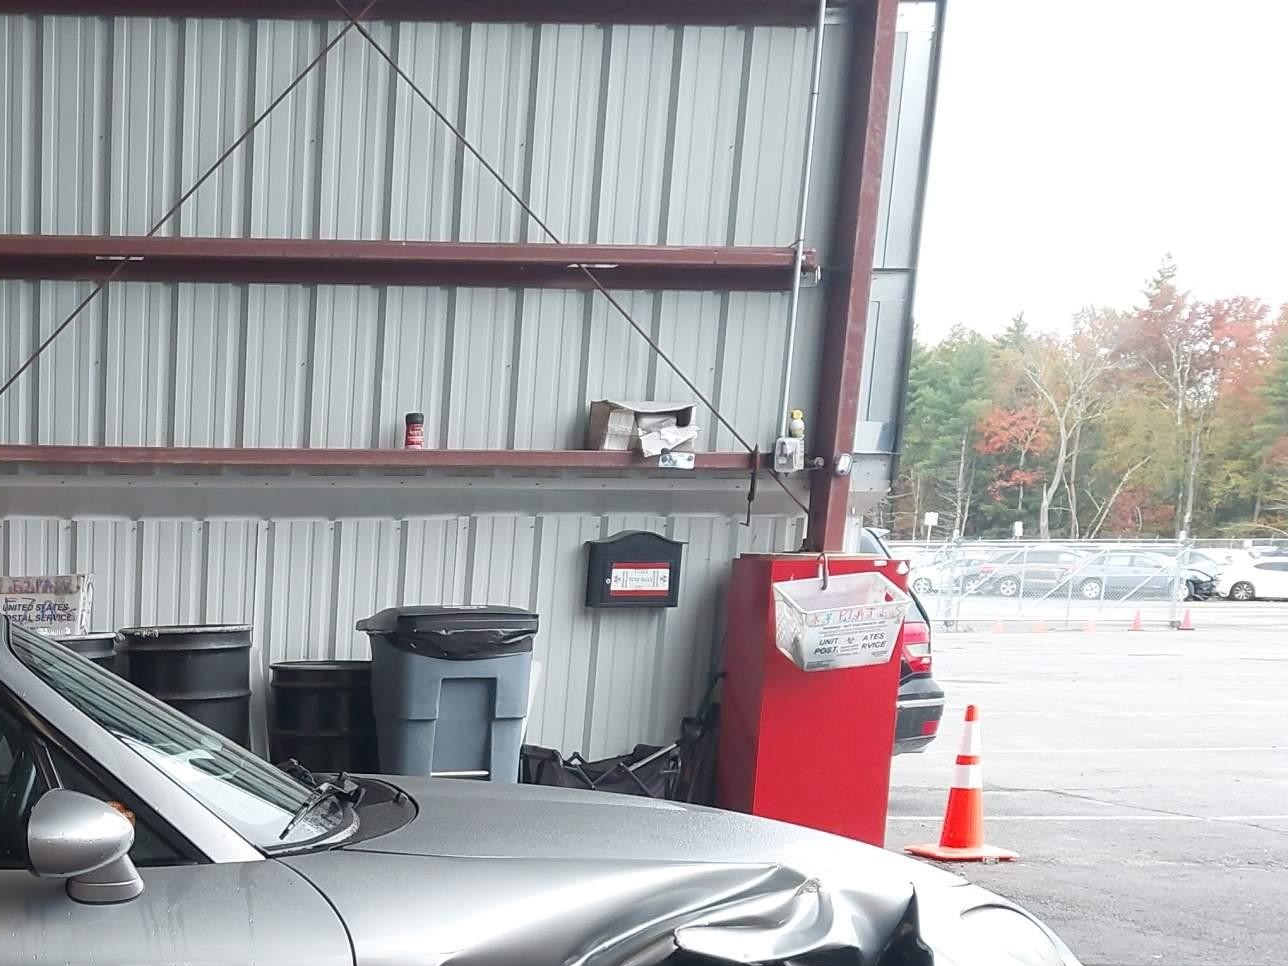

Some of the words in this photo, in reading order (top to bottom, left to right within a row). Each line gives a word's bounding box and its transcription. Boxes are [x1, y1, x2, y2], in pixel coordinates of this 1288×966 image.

[2, 603, 33, 611] UNITED
[36, 603, 70, 611] STATES
[6, 614, 33, 622] OSTAL
[35, 613, 73, 622] SERVICE
